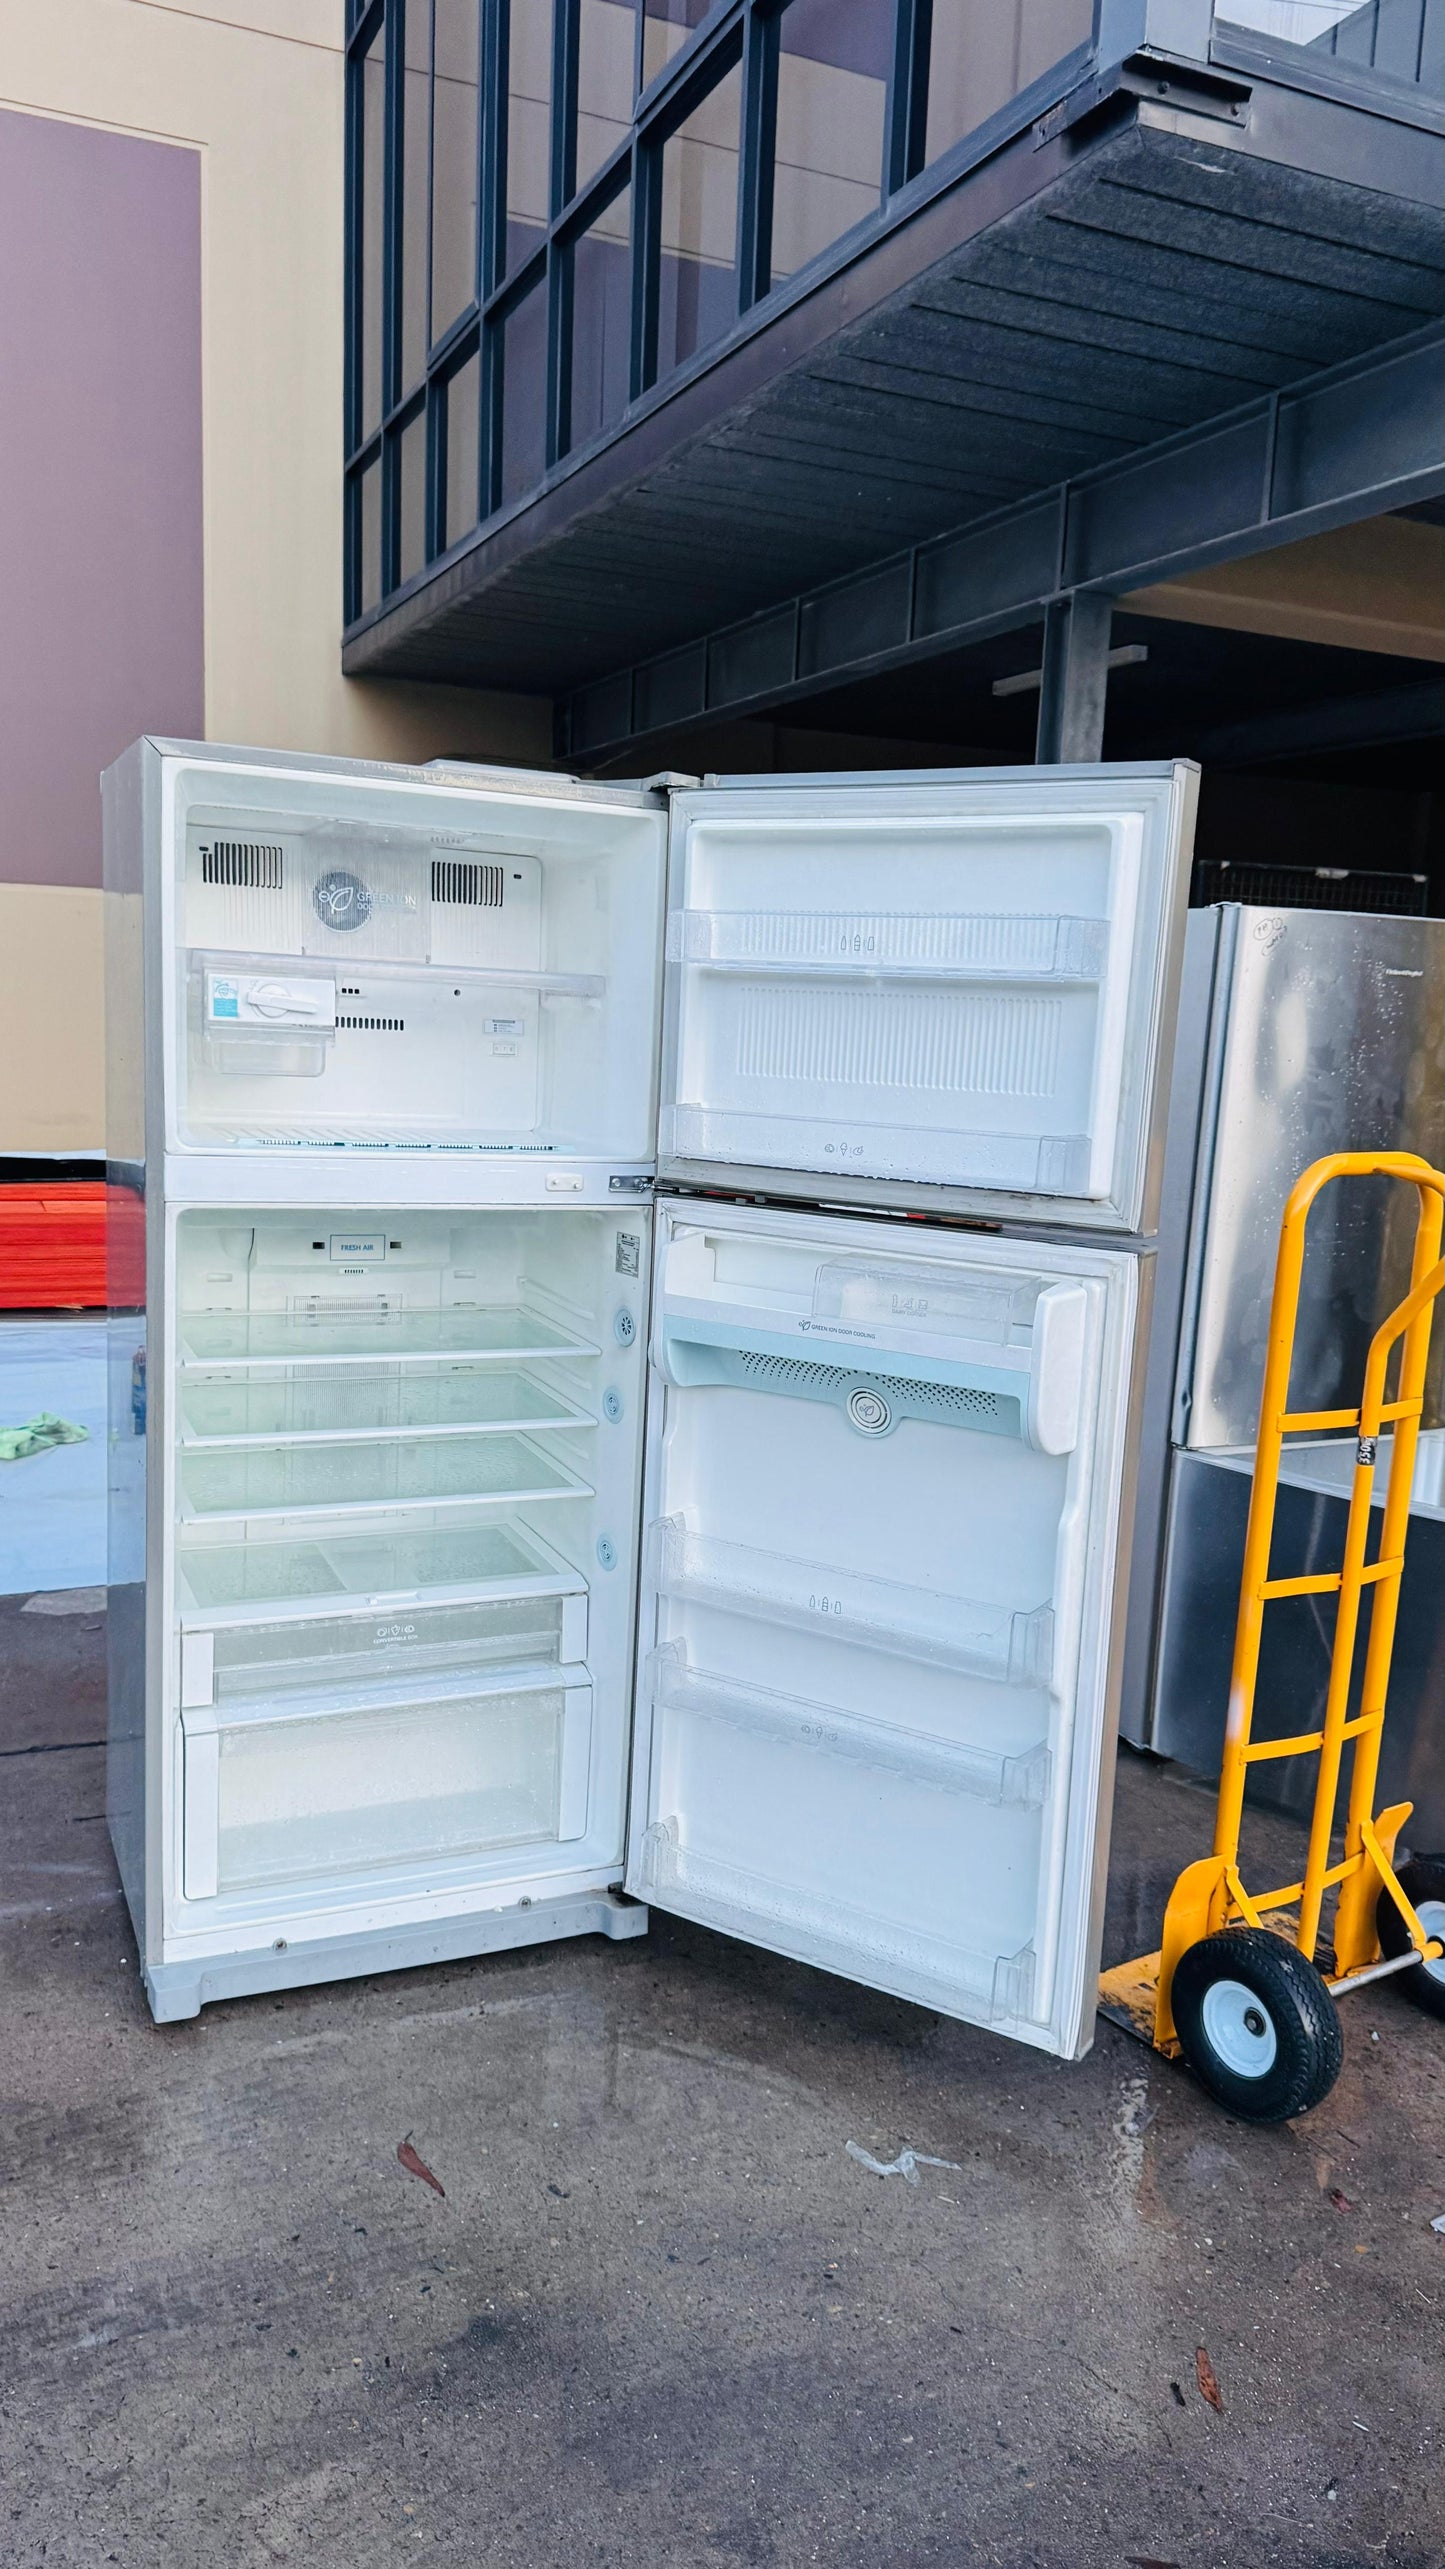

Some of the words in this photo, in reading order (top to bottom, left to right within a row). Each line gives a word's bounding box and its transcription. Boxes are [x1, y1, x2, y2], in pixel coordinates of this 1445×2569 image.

[357, 891, 393, 903] GREEN
[397, 894, 416, 905] ION
[811, 1324, 828, 1332] GREEN
[853, 1331, 876, 1340] COOLING
